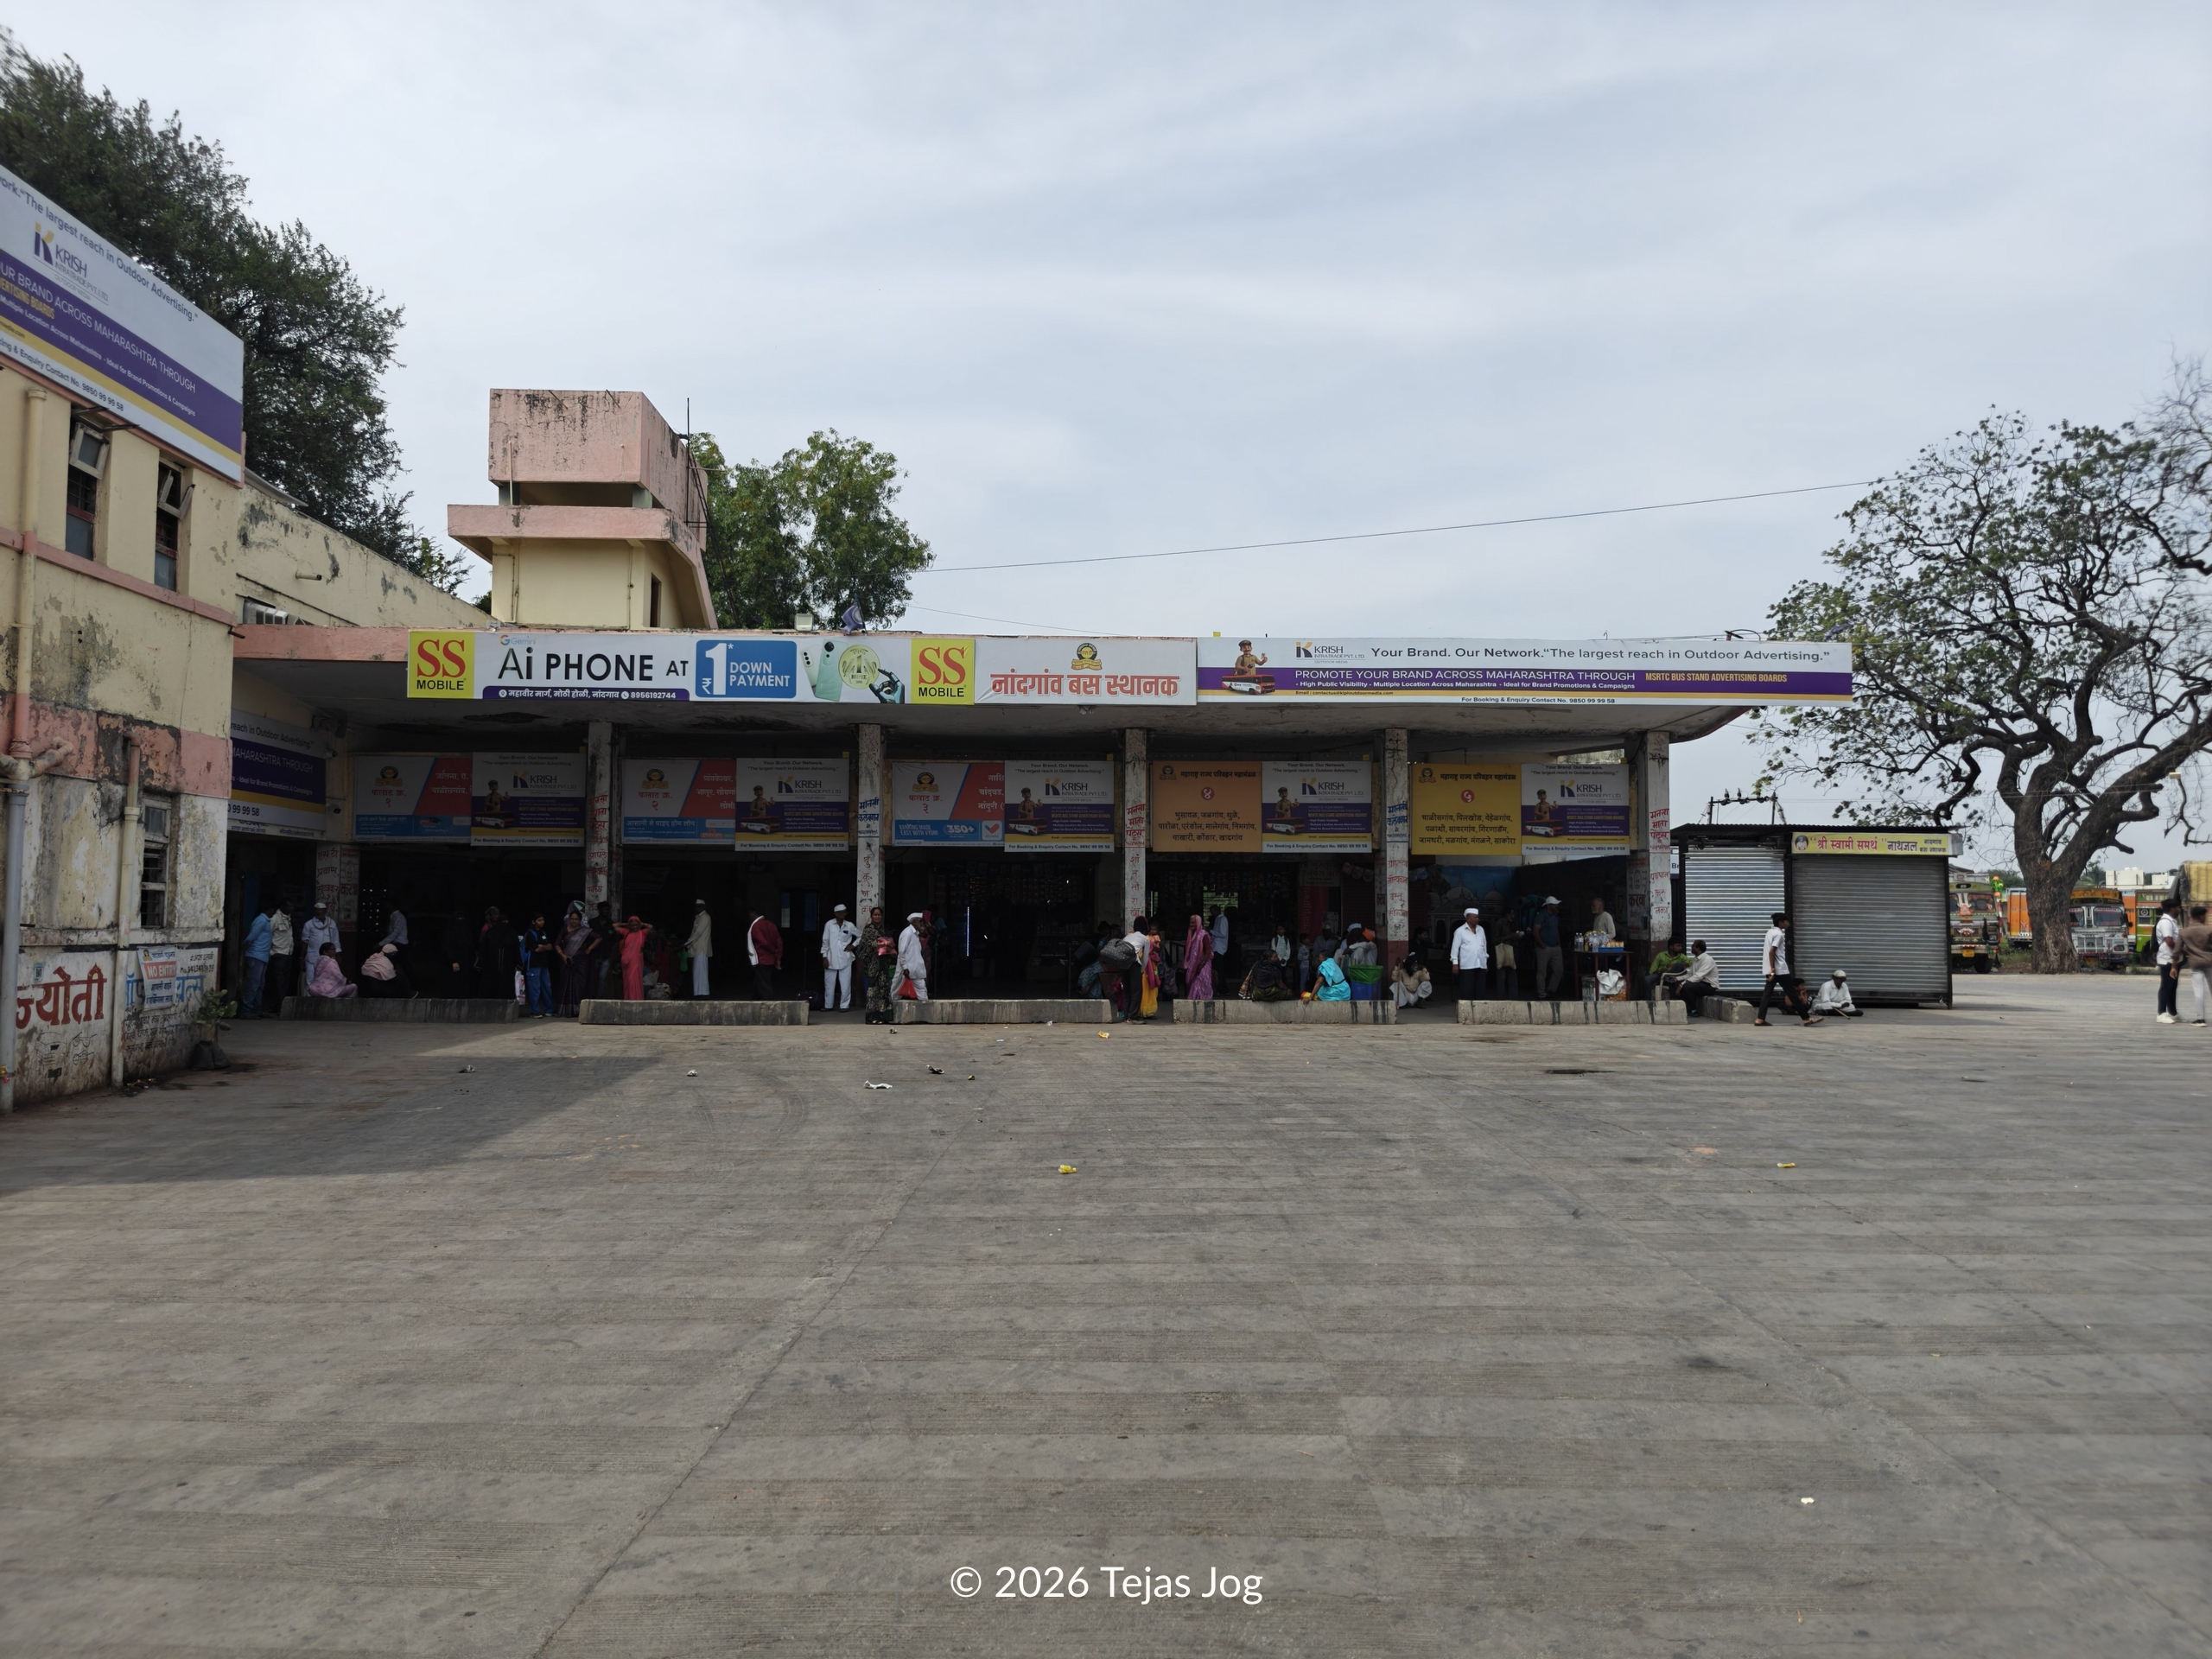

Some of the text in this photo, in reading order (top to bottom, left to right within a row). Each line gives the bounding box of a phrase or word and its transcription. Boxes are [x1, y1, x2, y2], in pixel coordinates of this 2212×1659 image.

[46, 207, 78, 238] largest
[80, 234, 104, 256] reach
[106, 250, 114, 264] in
[117, 259, 149, 288] Outdoor
[55, 244, 87, 277] KRISH
[18, 273, 195, 393] BRAND ACROSS MAHARASHTRA THROUGH
[20, 349, 44, 369] Enquiry
[46, 364, 69, 382] Contact
[71, 377, 80, 388] No.
[82, 384, 98, 397] 9850
[99, 392, 106, 402] 99
[108, 397, 115, 406] 99
[117, 403, 124, 411] 58
[511, 636, 536, 645] Gemini
[417, 639, 466, 678] SS
[1371, 648, 1403, 657] Your
[1408, 648, 1450, 657] Brand.
[1455, 648, 1480, 657] Our
[1580, 649, 1624, 660] largest
[1629, 650, 1663, 658] reach
[1669, 650, 1680, 658] in
[1685, 650, 1739, 658] Outdoor
[498, 647, 690, 681] Ai PHONE AT
[730, 662, 772, 673] DOWN
[916, 647, 967, 686] SS
[730, 675, 791, 687] PAYMENT
[1486, 671, 1574, 680] MAHARASHTRA
[1711, 673, 1757, 682] ADVERTISING
[416, 680, 464, 690] MOBILE
[988, 669, 1179, 697] नांदगांव बस स्थानक
[508, 689, 534, 698] महावीर
[535, 689, 552, 698] मार्ग,
[553, 690, 570, 698] मोठी
[571, 689, 590, 699] होळी,
[918, 687, 964, 697] MOBILE
[231, 722, 248, 733] reach
[249, 725, 254, 734] in
[256, 727, 279, 740] Outdoor
[282, 757, 313, 773] THROUGH
[1204, 788, 1211, 800] ४
[1464, 791, 1471, 803] ५
[232, 804, 259, 816] 99 99 58
[652, 801, 658, 810] २
[923, 803, 928, 814] ३
[1175, 811, 1199, 820] भुसावळ,
[946, 825, 975, 834] 350+
[1159, 822, 1180, 830] पारोळा,
[1205, 822, 1230, 830] मालेगांव,
[1830, 836, 1853, 851] स्वामी
[148, 966, 157, 978] NO
